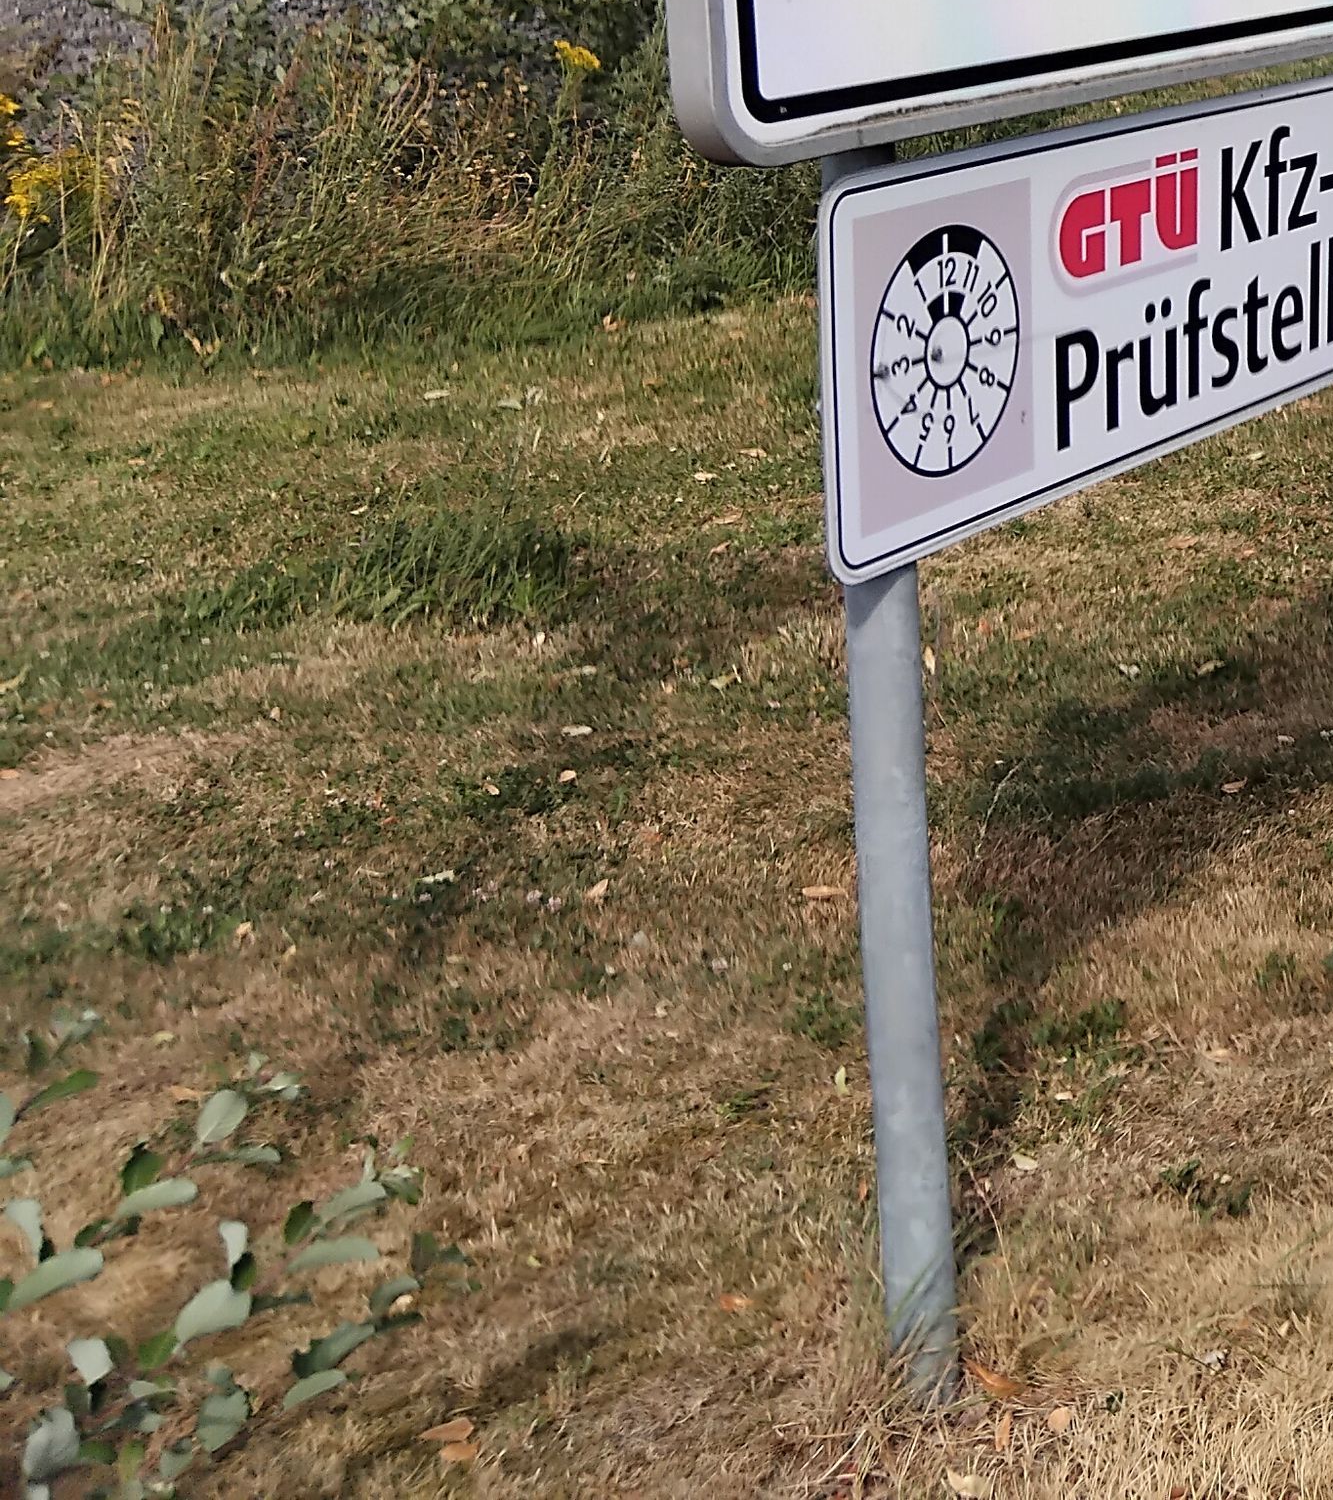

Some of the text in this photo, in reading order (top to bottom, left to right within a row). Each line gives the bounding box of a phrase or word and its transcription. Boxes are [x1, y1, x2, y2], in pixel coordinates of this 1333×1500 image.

[1059, 148, 1198, 278] GTÜ
[937, 257, 957, 288] 12
[963, 260, 980, 292] 11
[977, 281, 998, 318] 10
[896, 314, 915, 339] 2
[984, 328, 1001, 346] 9
[891, 356, 910, 377] 3
[979, 367, 995, 386] 8
[901, 394, 918, 415] 4
[919, 412, 934, 442] 5
[943, 415, 955, 444] 6
